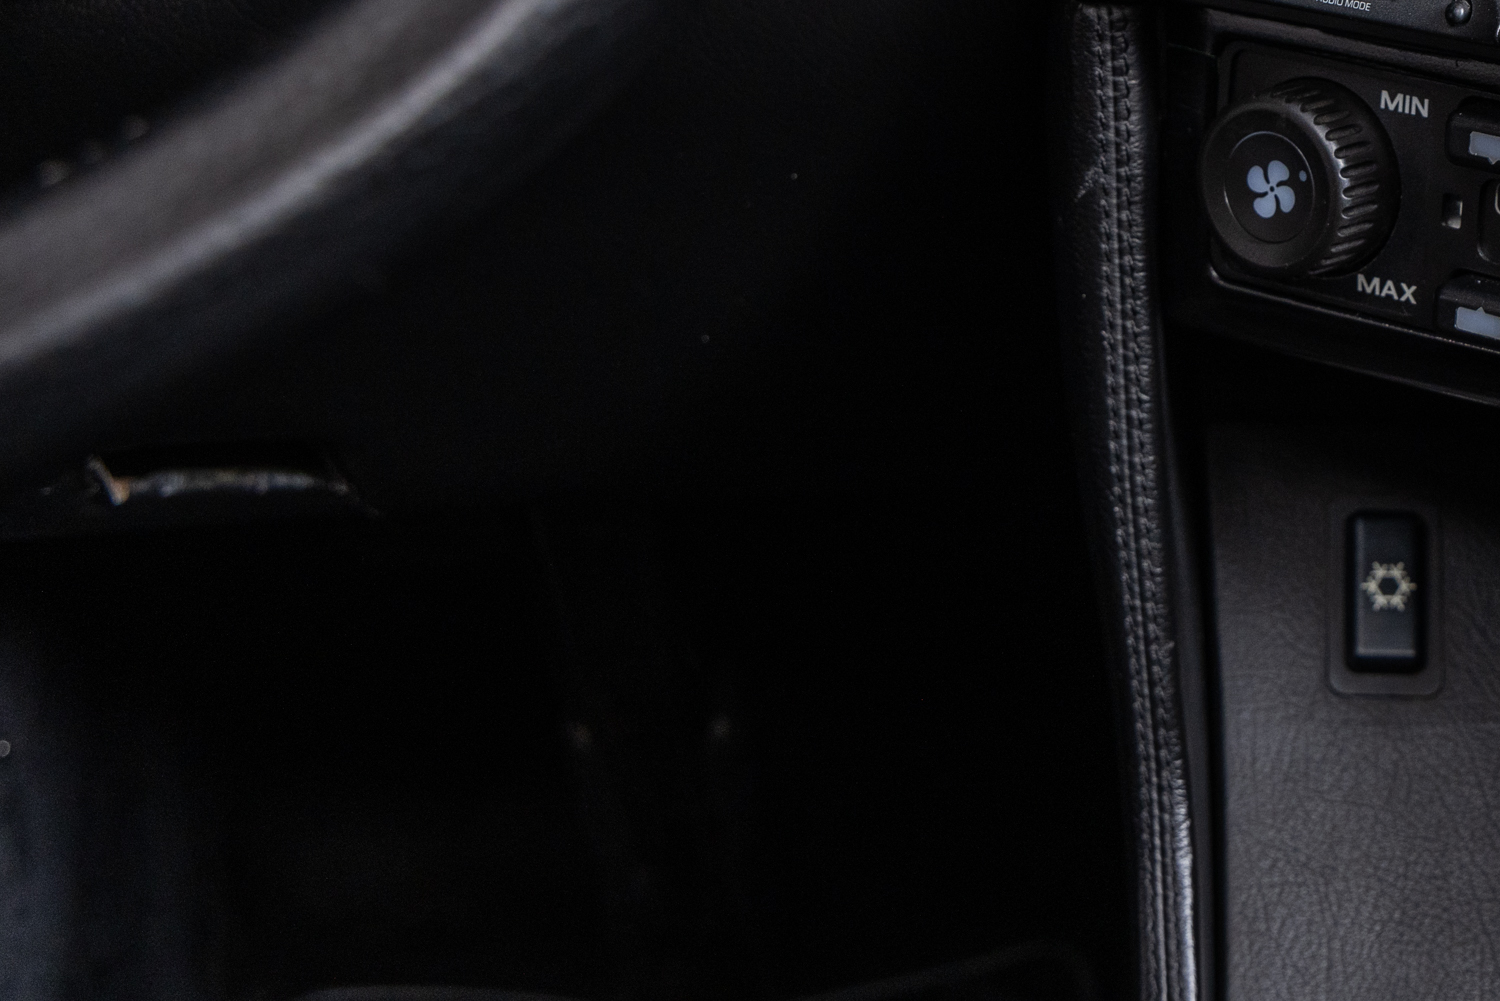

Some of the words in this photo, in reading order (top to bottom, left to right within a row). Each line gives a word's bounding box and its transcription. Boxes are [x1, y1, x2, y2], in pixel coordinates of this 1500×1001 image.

[1345, 0, 1371, 11] MODE
[1380, 89, 1429, 118] MIN
[1356, 273, 1417, 305] MAX
